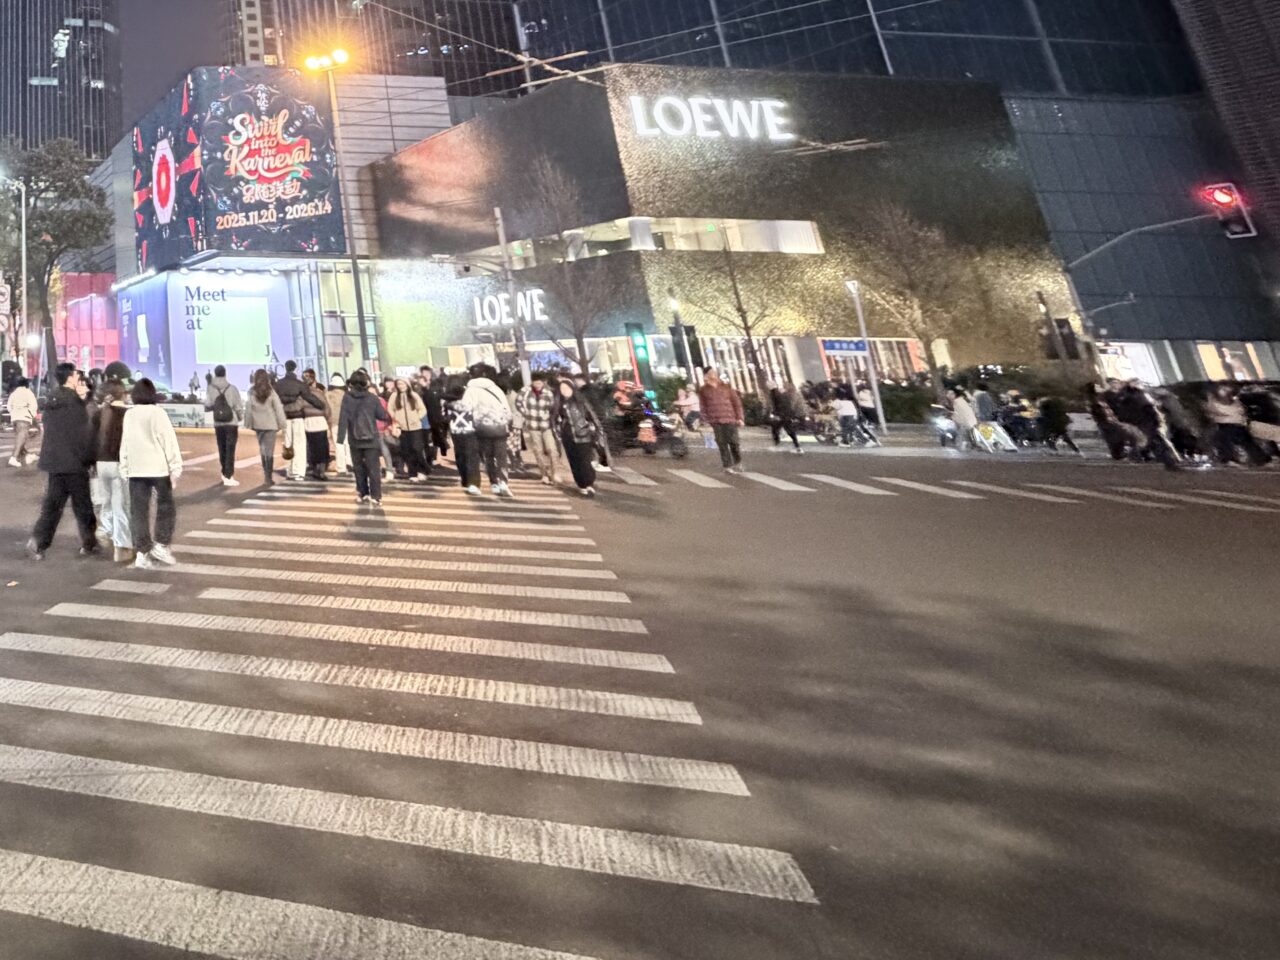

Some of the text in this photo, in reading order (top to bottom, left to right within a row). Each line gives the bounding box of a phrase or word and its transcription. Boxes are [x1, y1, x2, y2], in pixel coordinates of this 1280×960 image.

[228, 109, 291, 145] Swirl
[629, 95, 795, 140] LOEWE
[250, 137, 277, 149] into
[261, 147, 276, 156] the
[223, 139, 312, 180] Karneval
[216, 209, 277, 230] 2025.11.20
[285, 199, 332, 220] 2026.1.4
[185, 286, 227, 301] Meet
[185, 304, 211, 316] me
[473, 288, 549, 326] LOEWE
[186, 317, 203, 330] at
